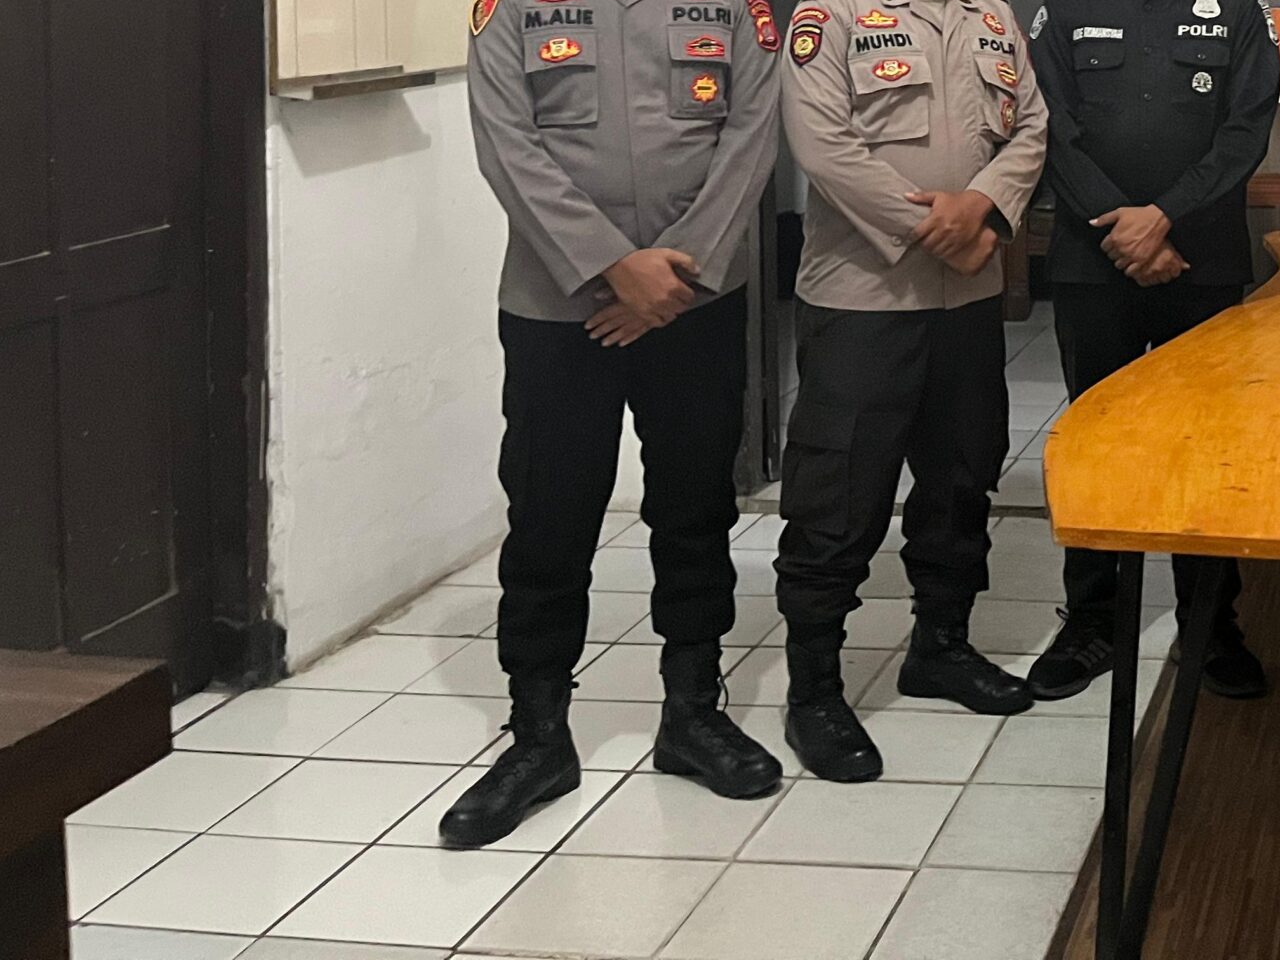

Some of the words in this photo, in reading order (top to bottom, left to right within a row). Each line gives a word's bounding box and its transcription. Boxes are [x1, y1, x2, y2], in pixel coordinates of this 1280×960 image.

[525, 8, 593, 29] M.ALIE
[672, 6, 732, 26] POLRI
[1177, 24, 1228, 38] POLRI
[855, 33, 913, 53] MUHDI
